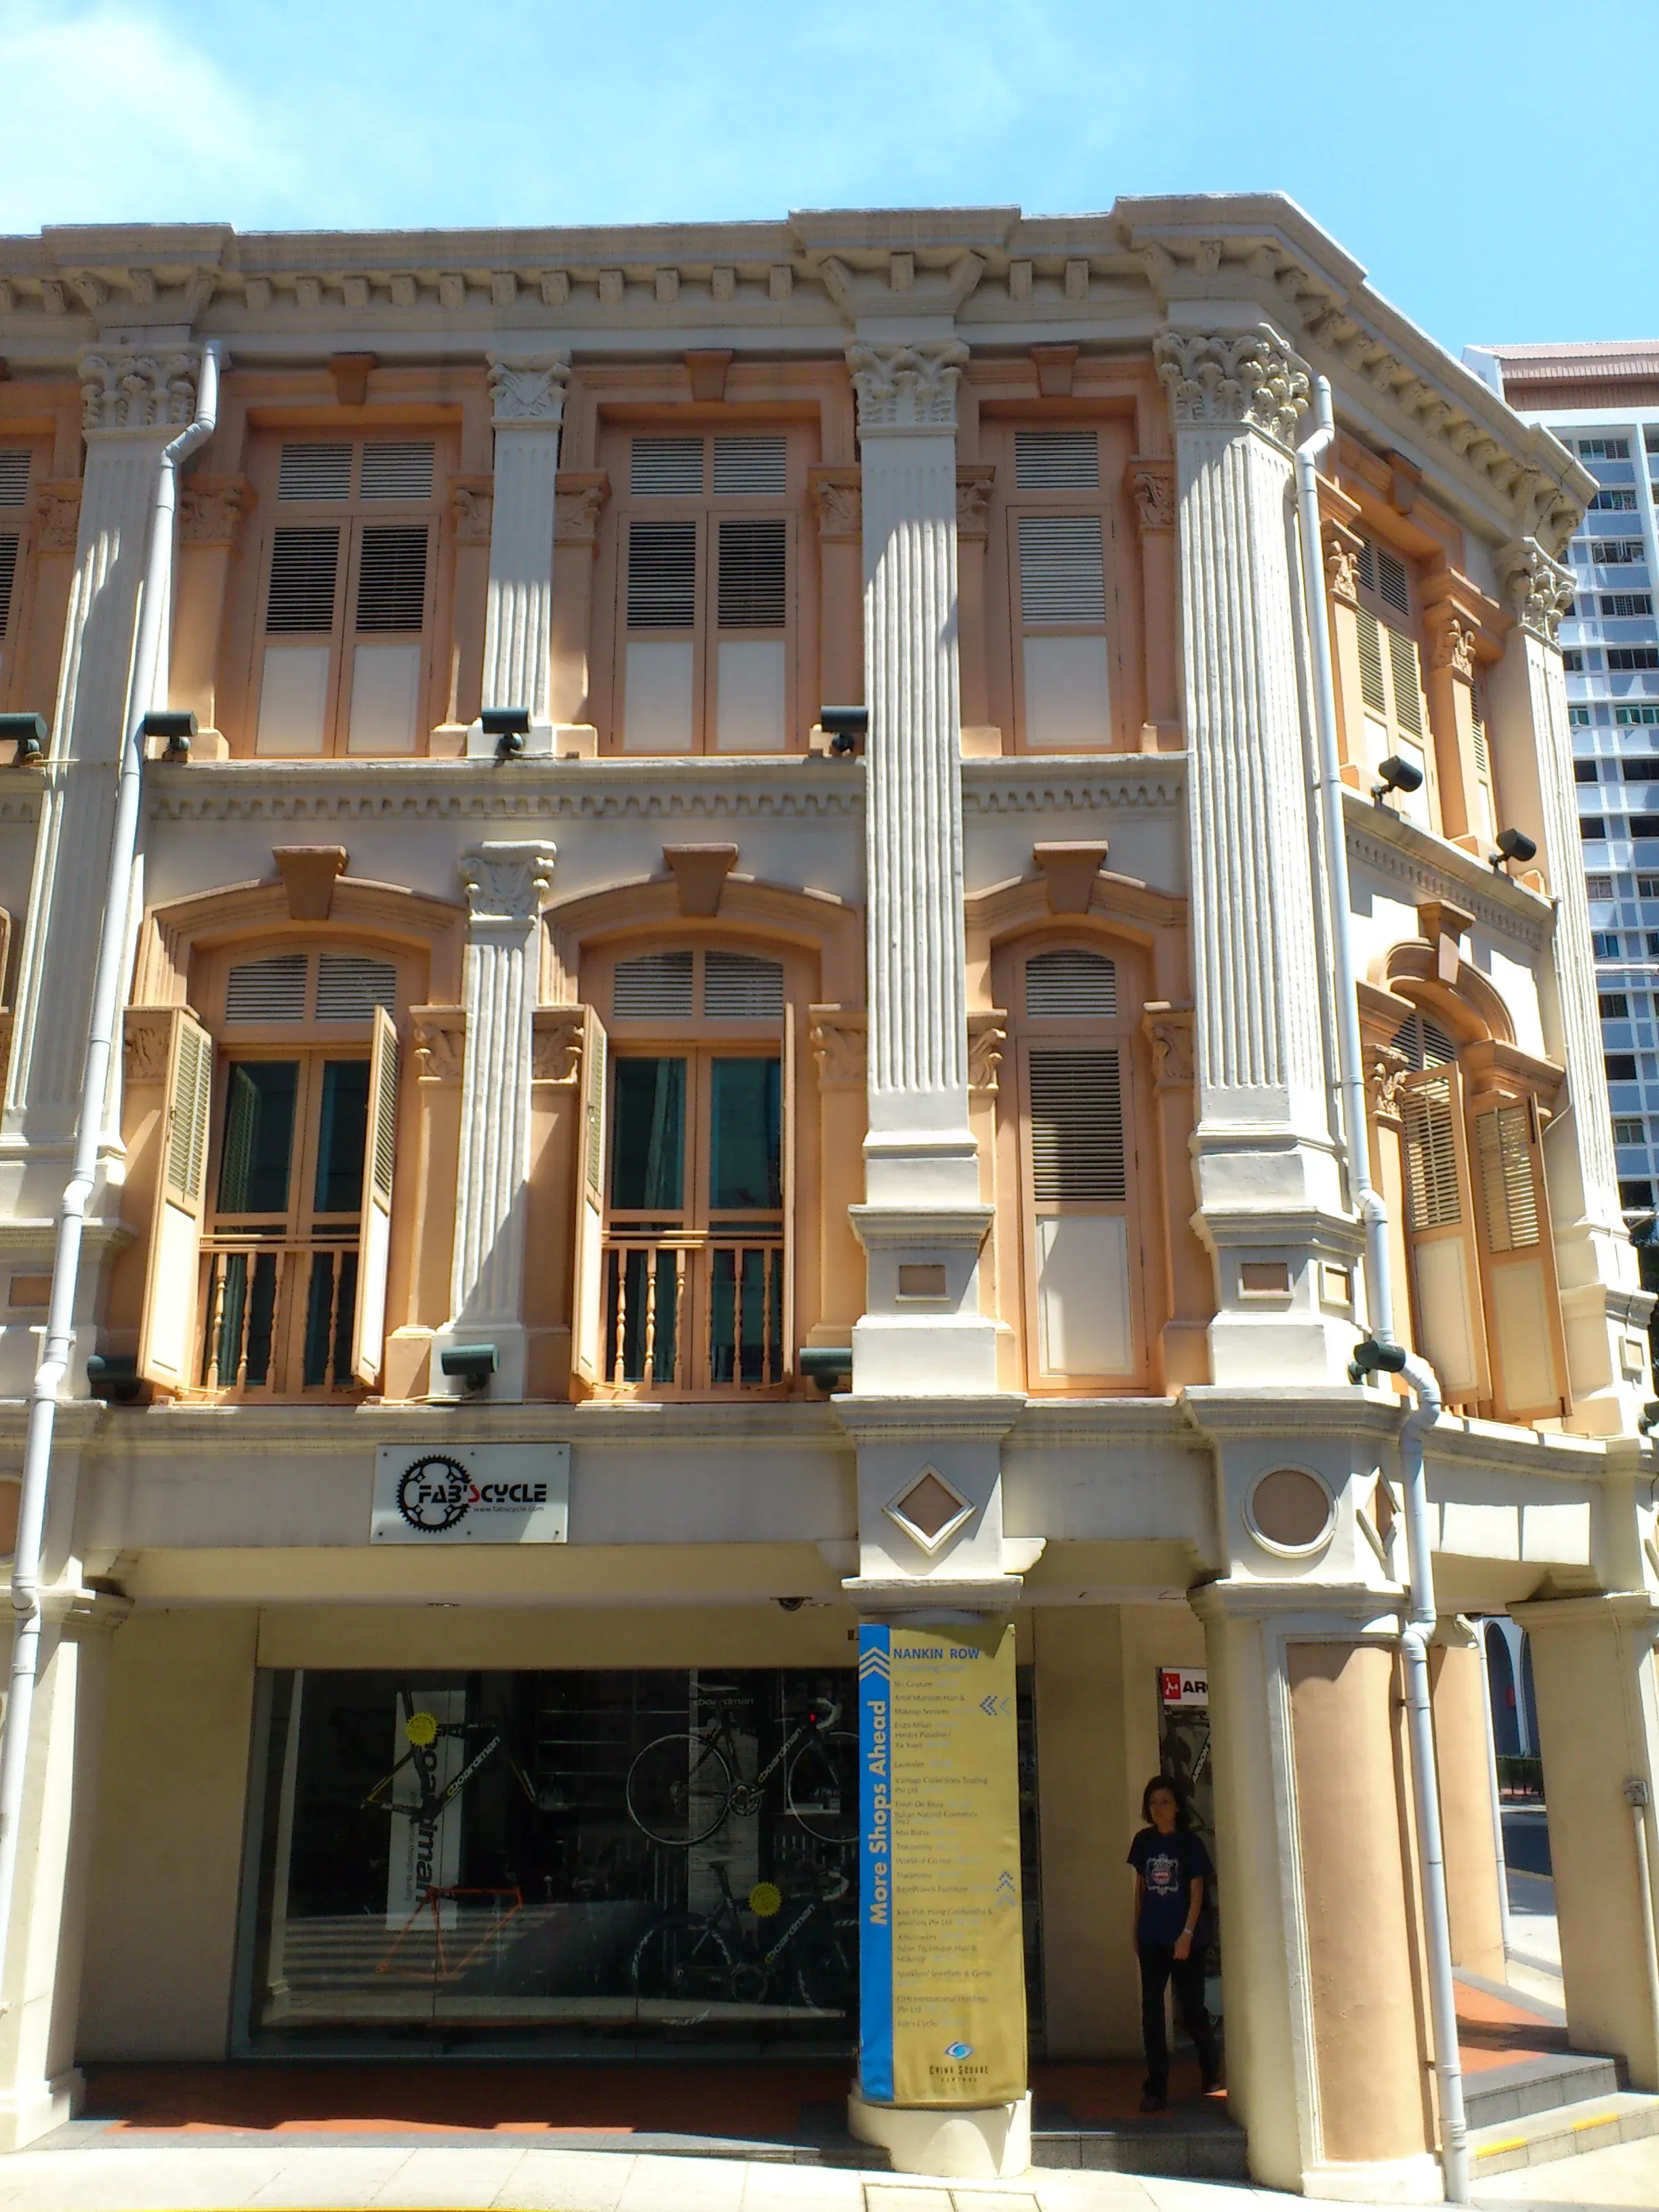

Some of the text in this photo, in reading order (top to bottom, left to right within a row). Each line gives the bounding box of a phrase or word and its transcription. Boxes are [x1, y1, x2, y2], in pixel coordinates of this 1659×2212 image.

[893, 1647, 981, 1660] NANKIN ROW
[1183, 1681, 1208, 1693] AR
[867, 1700, 891, 1925] More Shops Ahead
